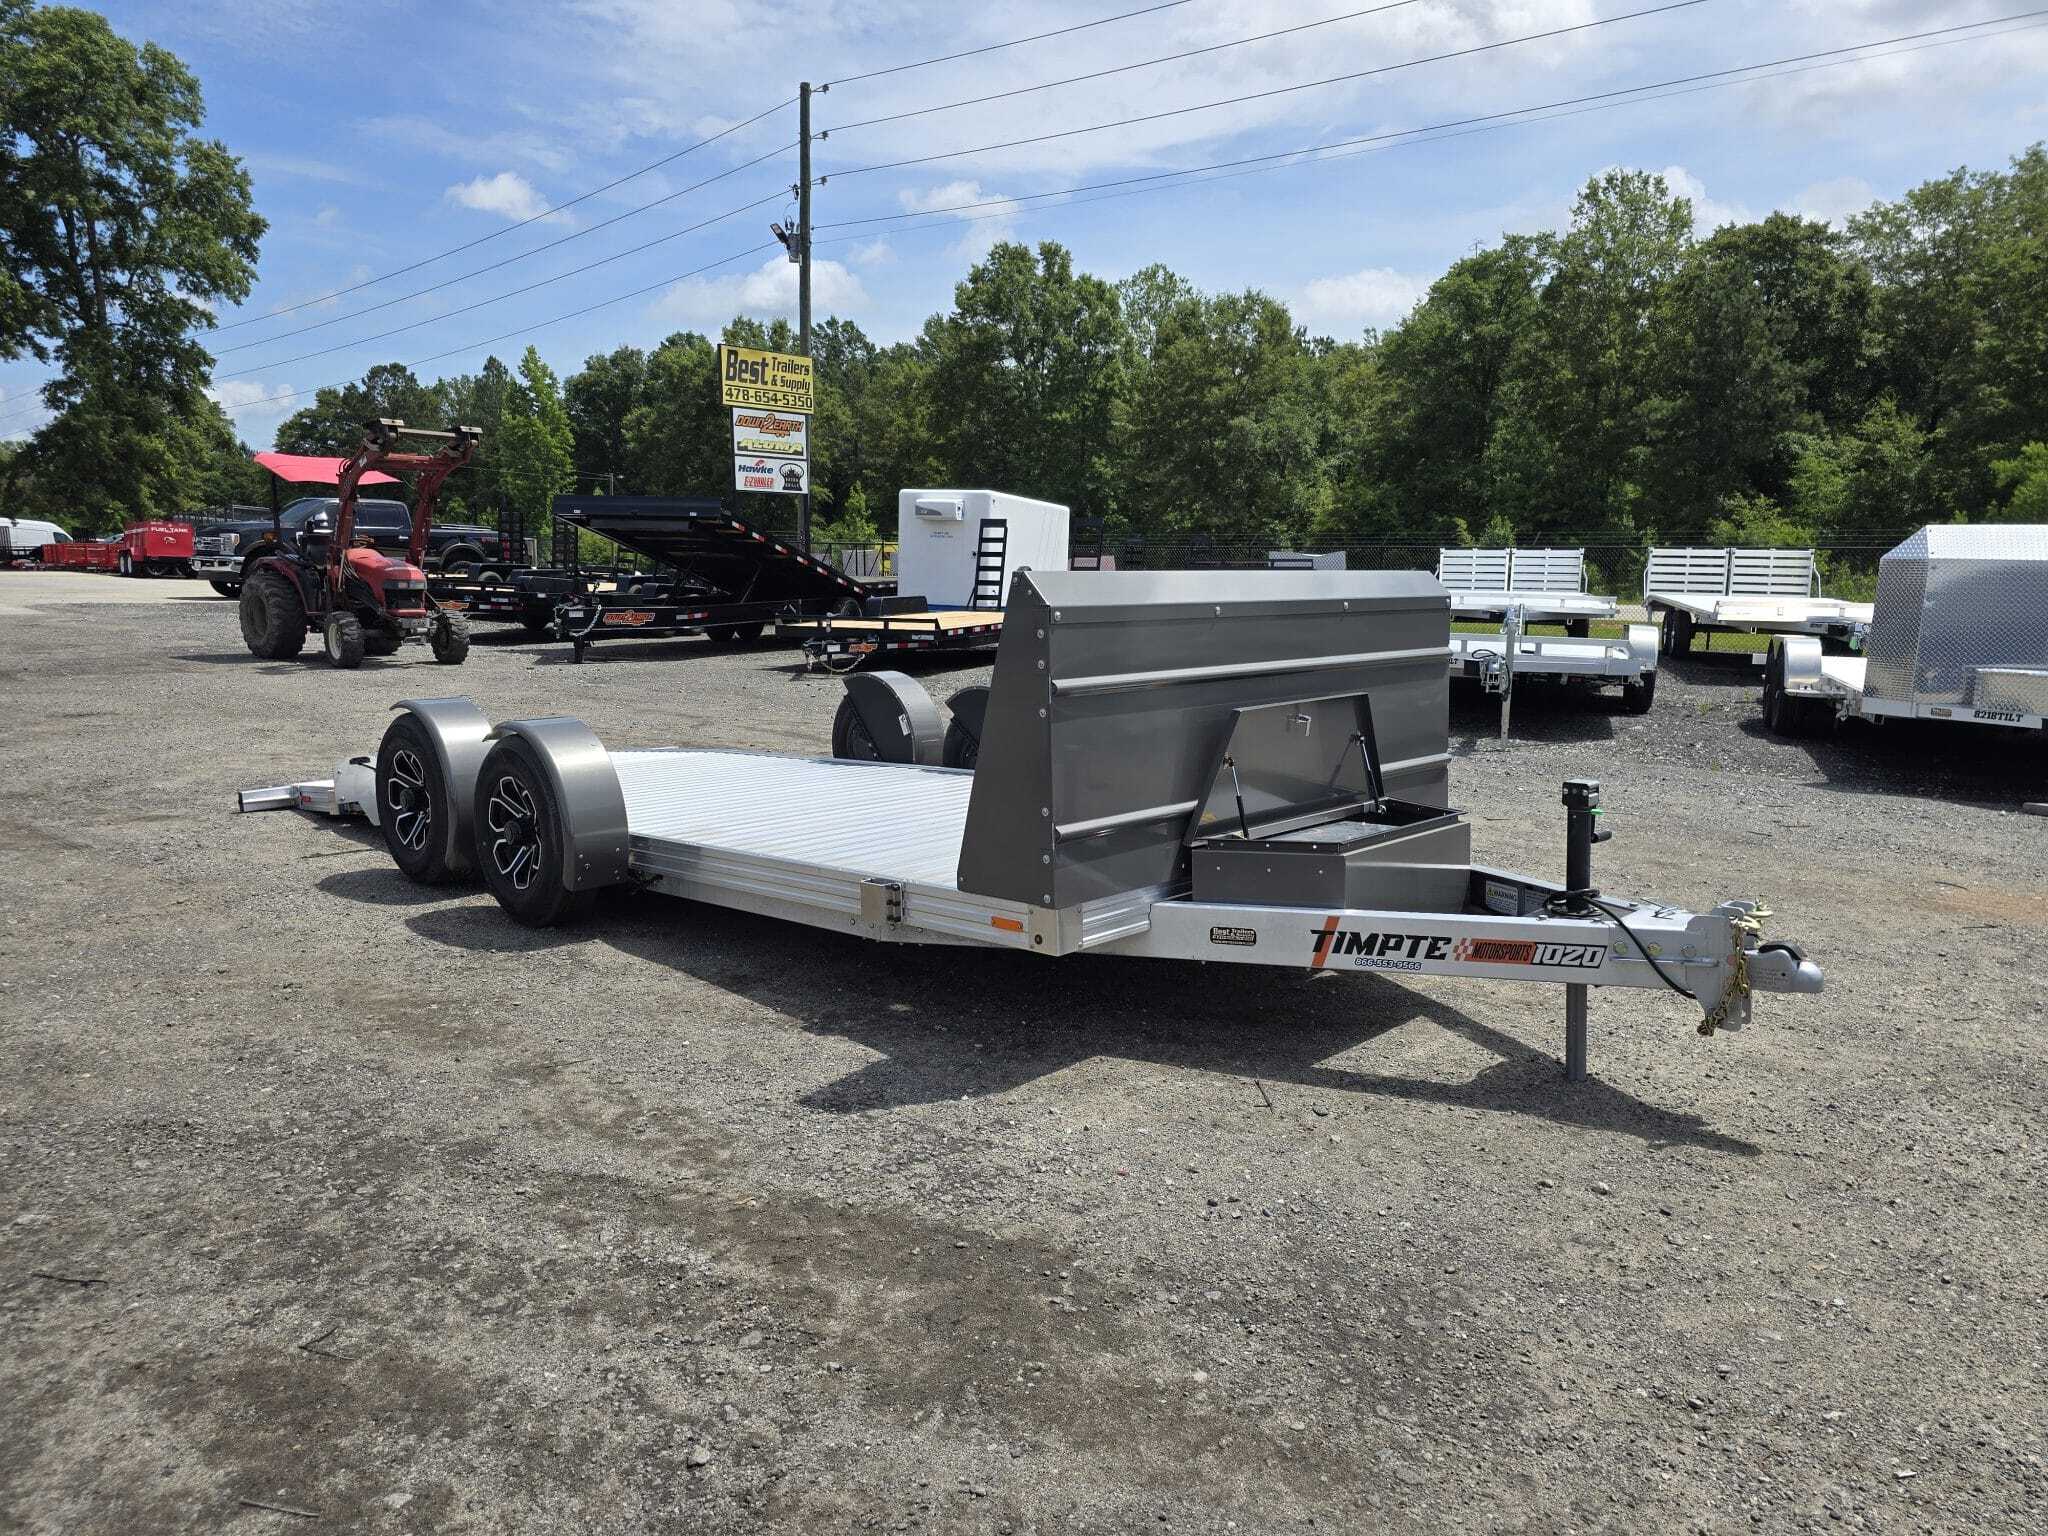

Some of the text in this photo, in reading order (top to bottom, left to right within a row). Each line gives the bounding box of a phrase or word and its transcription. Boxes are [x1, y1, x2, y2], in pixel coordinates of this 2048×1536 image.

[726, 350, 769, 385] Best
[771, 357, 810, 375] Trailers
[771, 374, 810, 393] & Supply
[725, 388, 813, 408] 478-654-5350
[738, 464, 774, 474] Hawke
[1310, 929, 1452, 960] TIMPTE
[1354, 957, 1422, 970] 866-553-9566
[1472, 942, 1606, 967] MOTORSPORTS 1020
